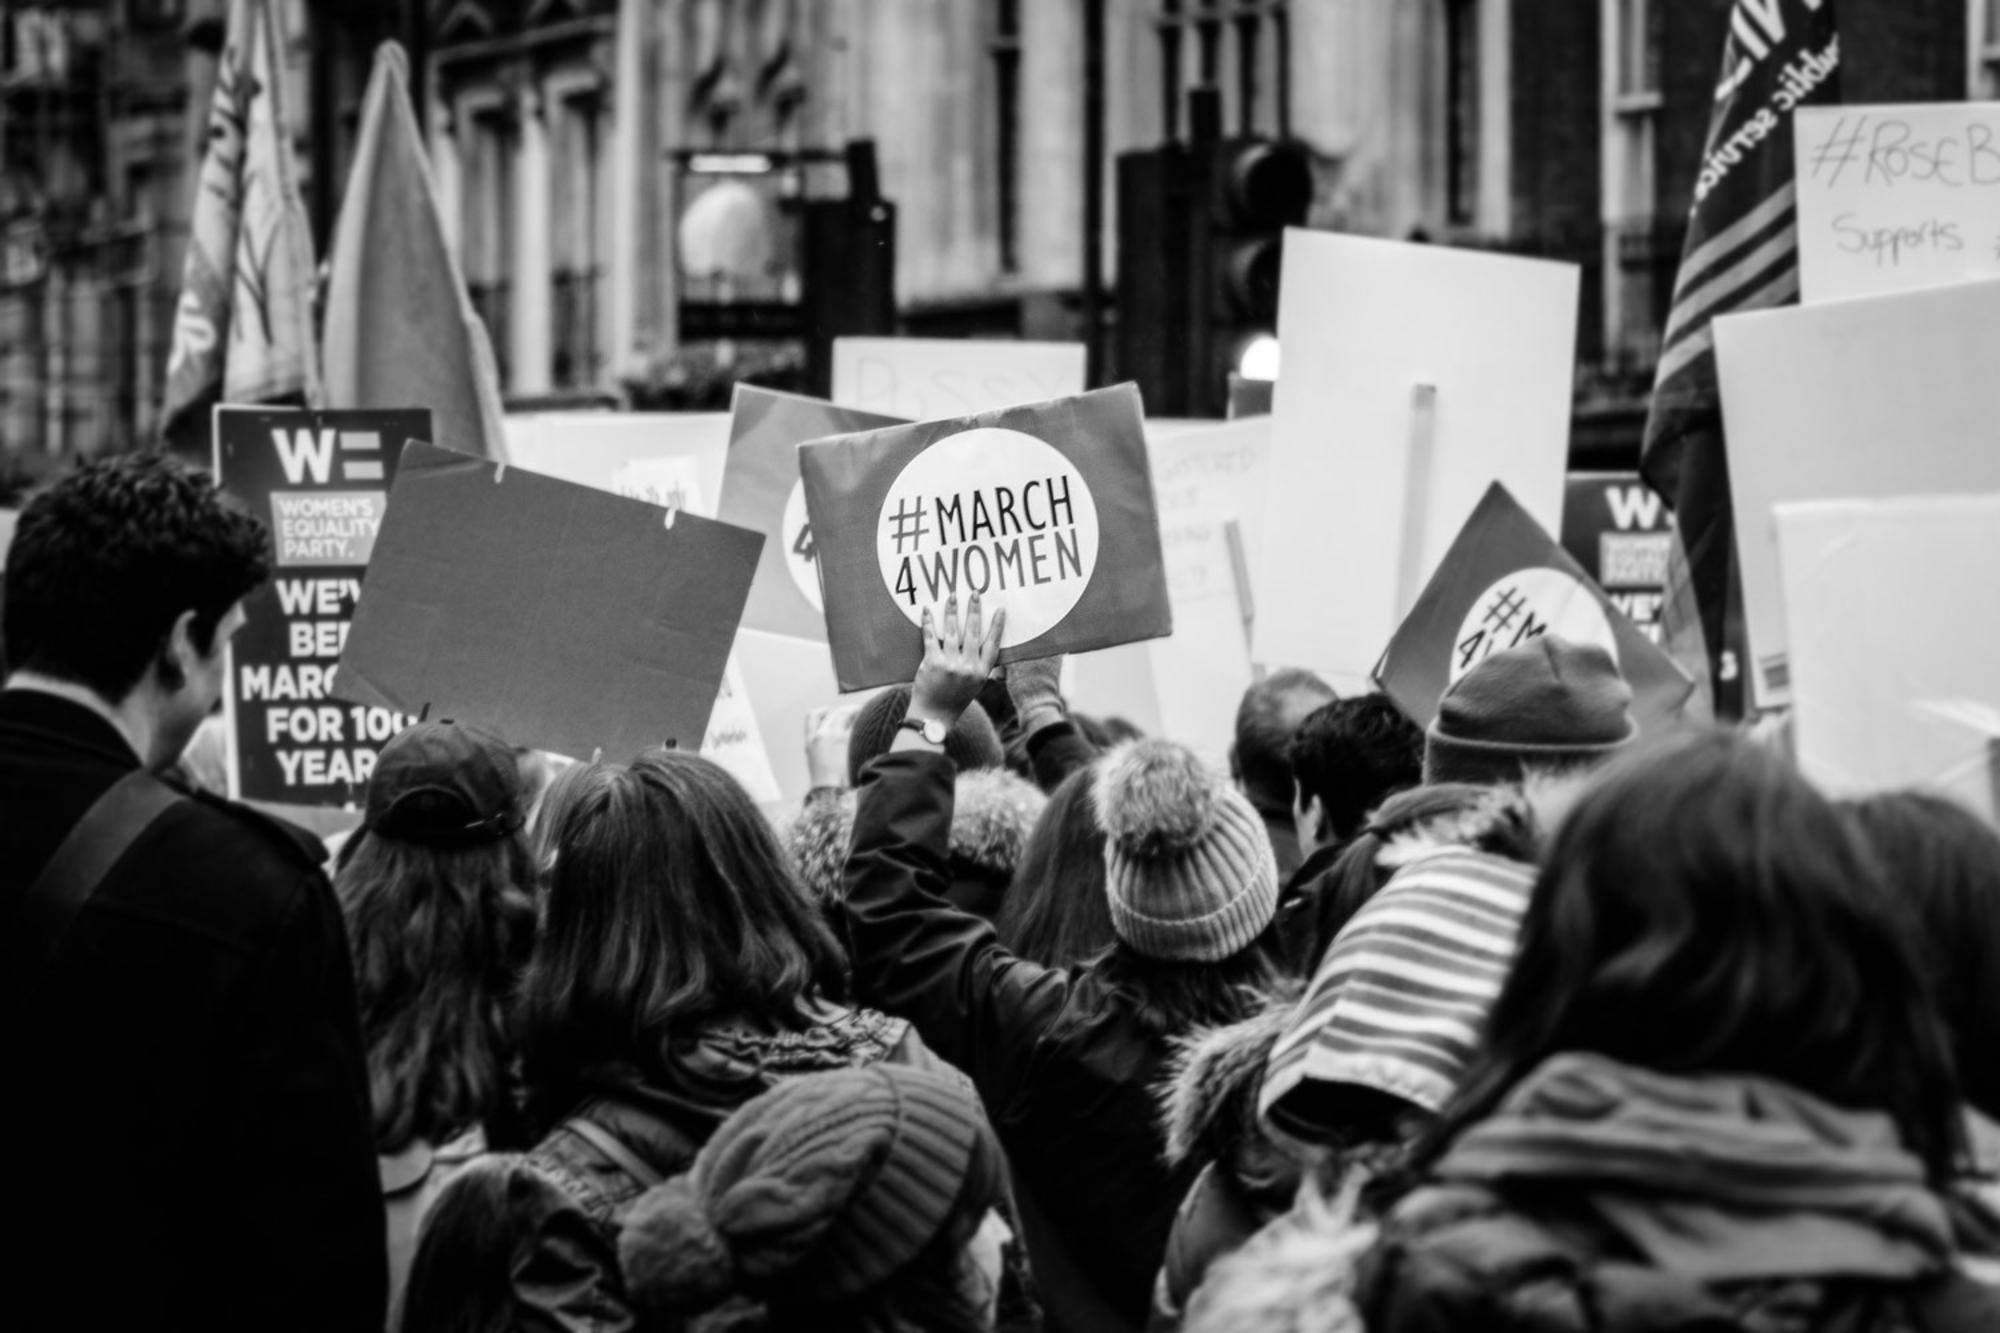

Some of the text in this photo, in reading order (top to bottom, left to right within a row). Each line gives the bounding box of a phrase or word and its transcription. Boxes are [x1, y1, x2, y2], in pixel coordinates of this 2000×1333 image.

[279, 497, 374, 518] WOMEN'S
[888, 475, 1074, 555] #MARCH
[281, 517, 381, 538] EQUALITY
[283, 538, 355, 559] PARTY.
[894, 528, 1083, 606] 4WOMEN
[266, 707, 344, 744] FOR
